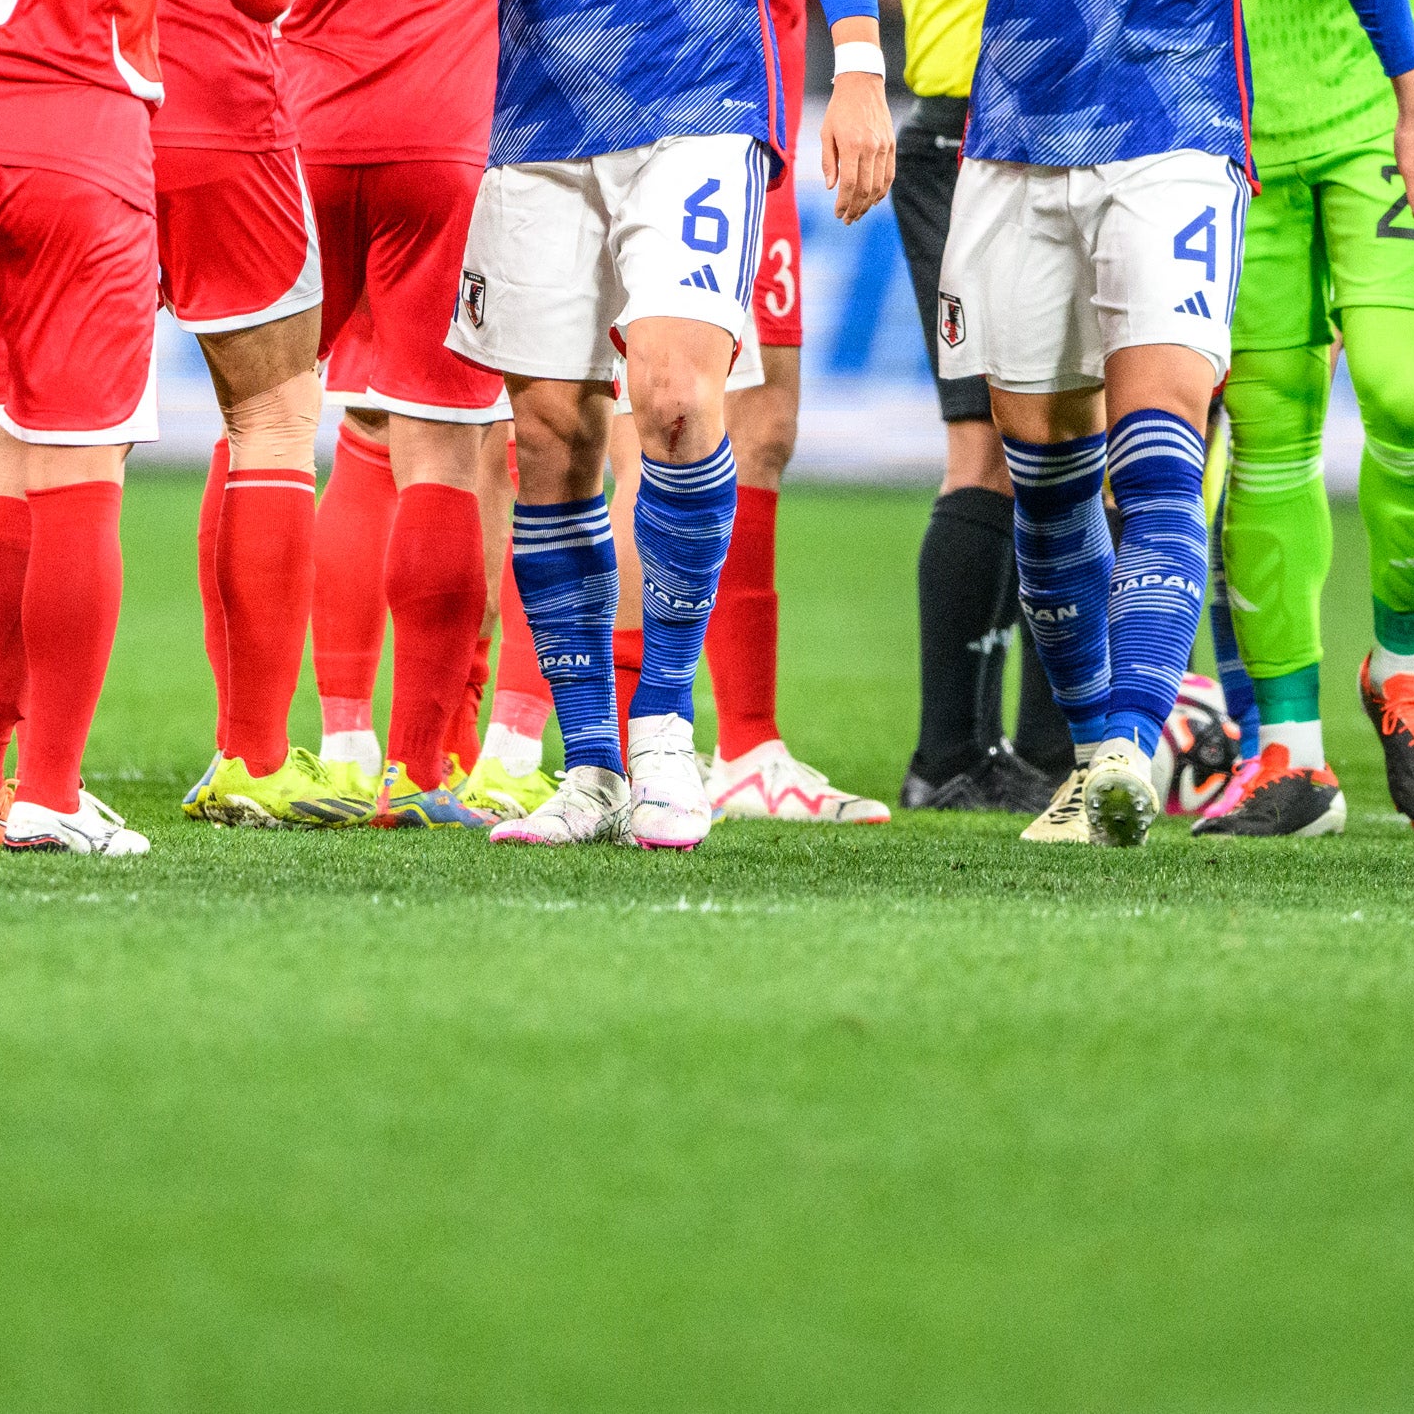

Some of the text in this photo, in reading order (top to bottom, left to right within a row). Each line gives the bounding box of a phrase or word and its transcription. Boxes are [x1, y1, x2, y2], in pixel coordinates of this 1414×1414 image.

[681, 178, 730, 255] 6
[1173, 205, 1218, 284] 4
[765, 238, 796, 318] 3
[1111, 574, 1200, 599] JAPAN
